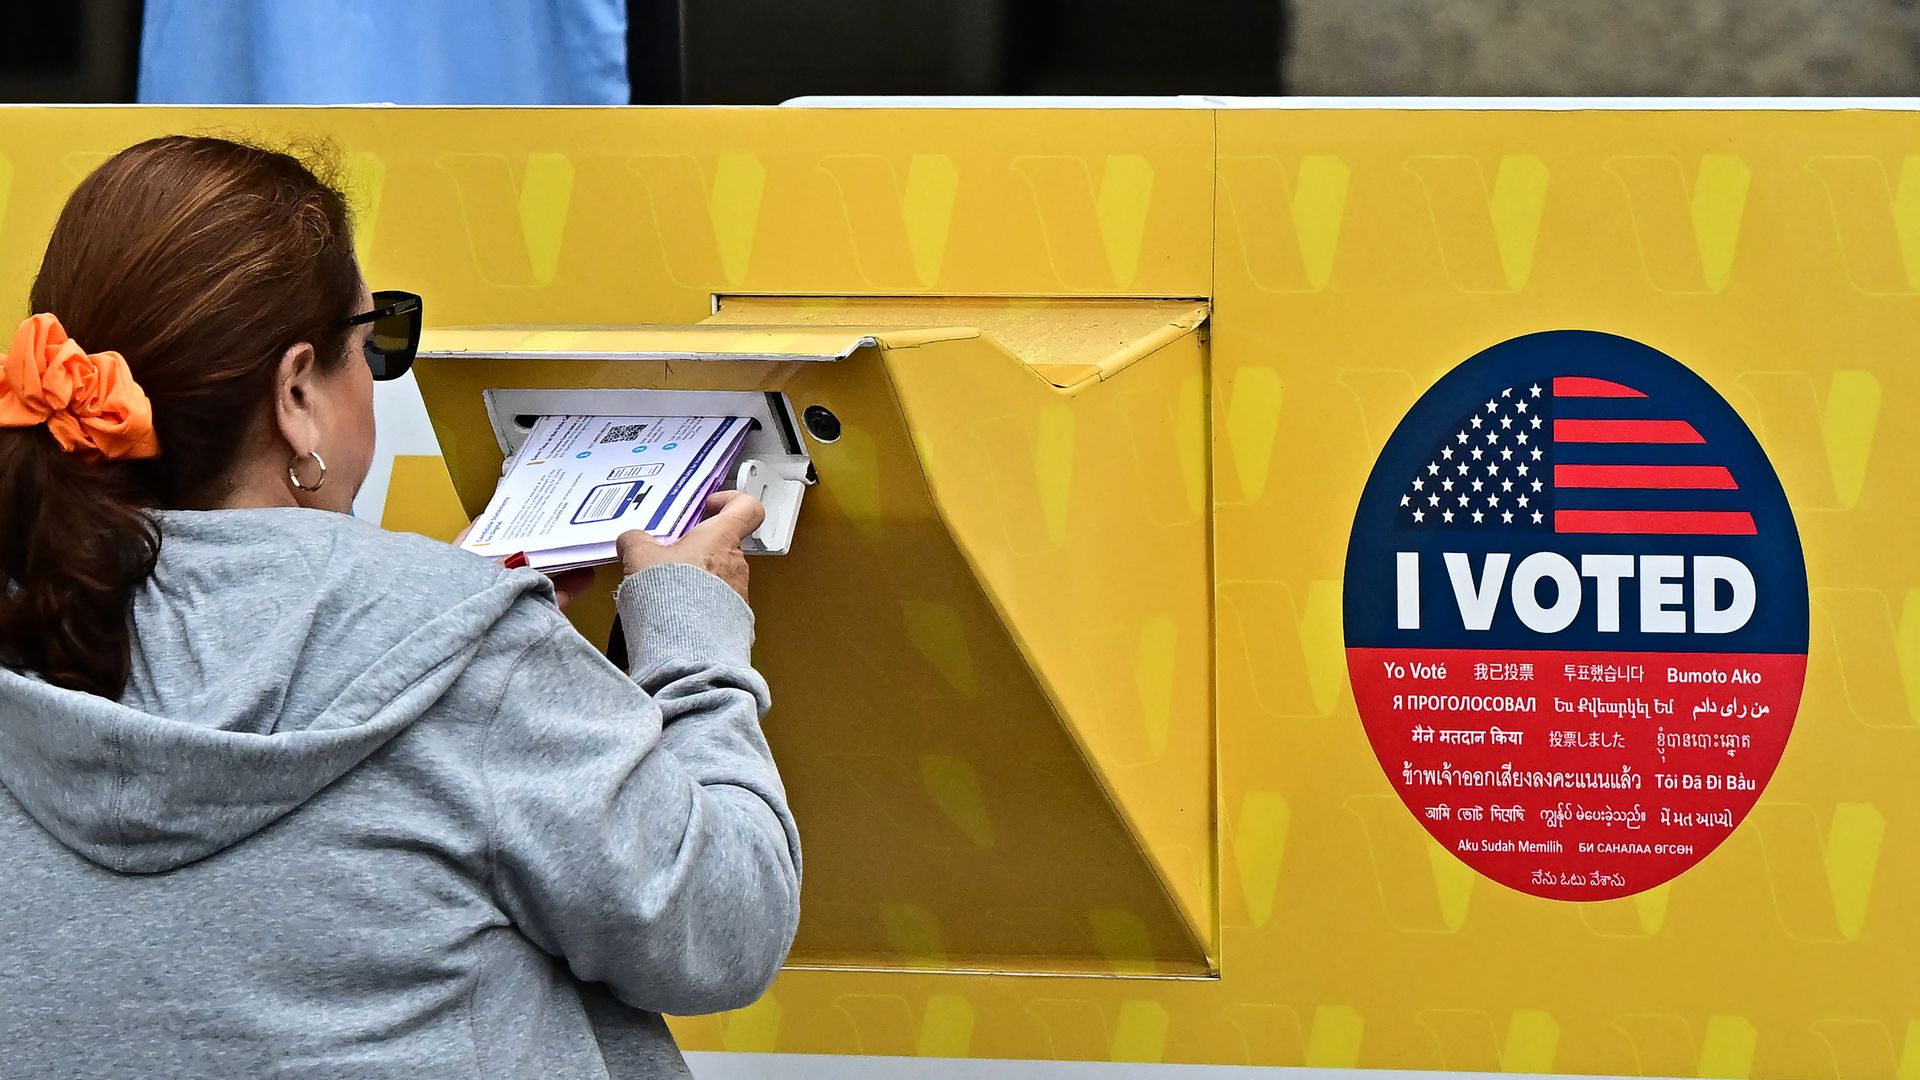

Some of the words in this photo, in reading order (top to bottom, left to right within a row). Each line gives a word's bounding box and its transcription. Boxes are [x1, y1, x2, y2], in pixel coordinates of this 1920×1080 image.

[1397, 552, 1419, 629] I
[1443, 552, 1756, 633] VOTED
[1384, 662, 1405, 678] Yo
[1410, 663, 1447, 679] Voté
[1474, 663, 1533, 681] 我已投票
[1564, 665, 1644, 682] 투표했습니다
[1668, 668, 1727, 683] Bumoto
[1731, 669, 1761, 684] Ako
[1393, 695, 1402, 709] Я
[1408, 695, 1536, 712] ПРОГОЛОСОВАЛ
[1554, 697, 1574, 712] Ես
[1577, 698, 1651, 718] Քվեարկել
[1654, 699, 1674, 714] Եմ
[1693, 697, 1717, 721] دادم
[1721, 697, 1747, 718] رای
[1751, 703, 1769, 718] من
[1439, 730, 1486, 745] मतदान
[1490, 726, 1523, 745] किया
[1549, 731, 1625, 748] 投票しました
[1403, 761, 1641, 789] ข้าพเจ้าออกเสียงลงคะแนนแล้ว
[1655, 774, 1677, 788] Tôi
[1682, 775, 1701, 789] Đã
[1706, 775, 1721, 789] Đi
[1727, 772, 1755, 790] Bầu
[1425, 804, 1450, 820] আমি
[1458, 805, 1483, 821] ভোট
[1674, 813, 1693, 826] મત
[1696, 809, 1733, 828] આપ્યો
[1458, 839, 1478, 851] Aku
[1482, 840, 1515, 852] Sudah
[1519, 841, 1562, 853] Memilih
[1579, 843, 1594, 852] БИ
[1597, 843, 1651, 853] САНАЛАА
[1655, 844, 1692, 854] ӨГСӨН
